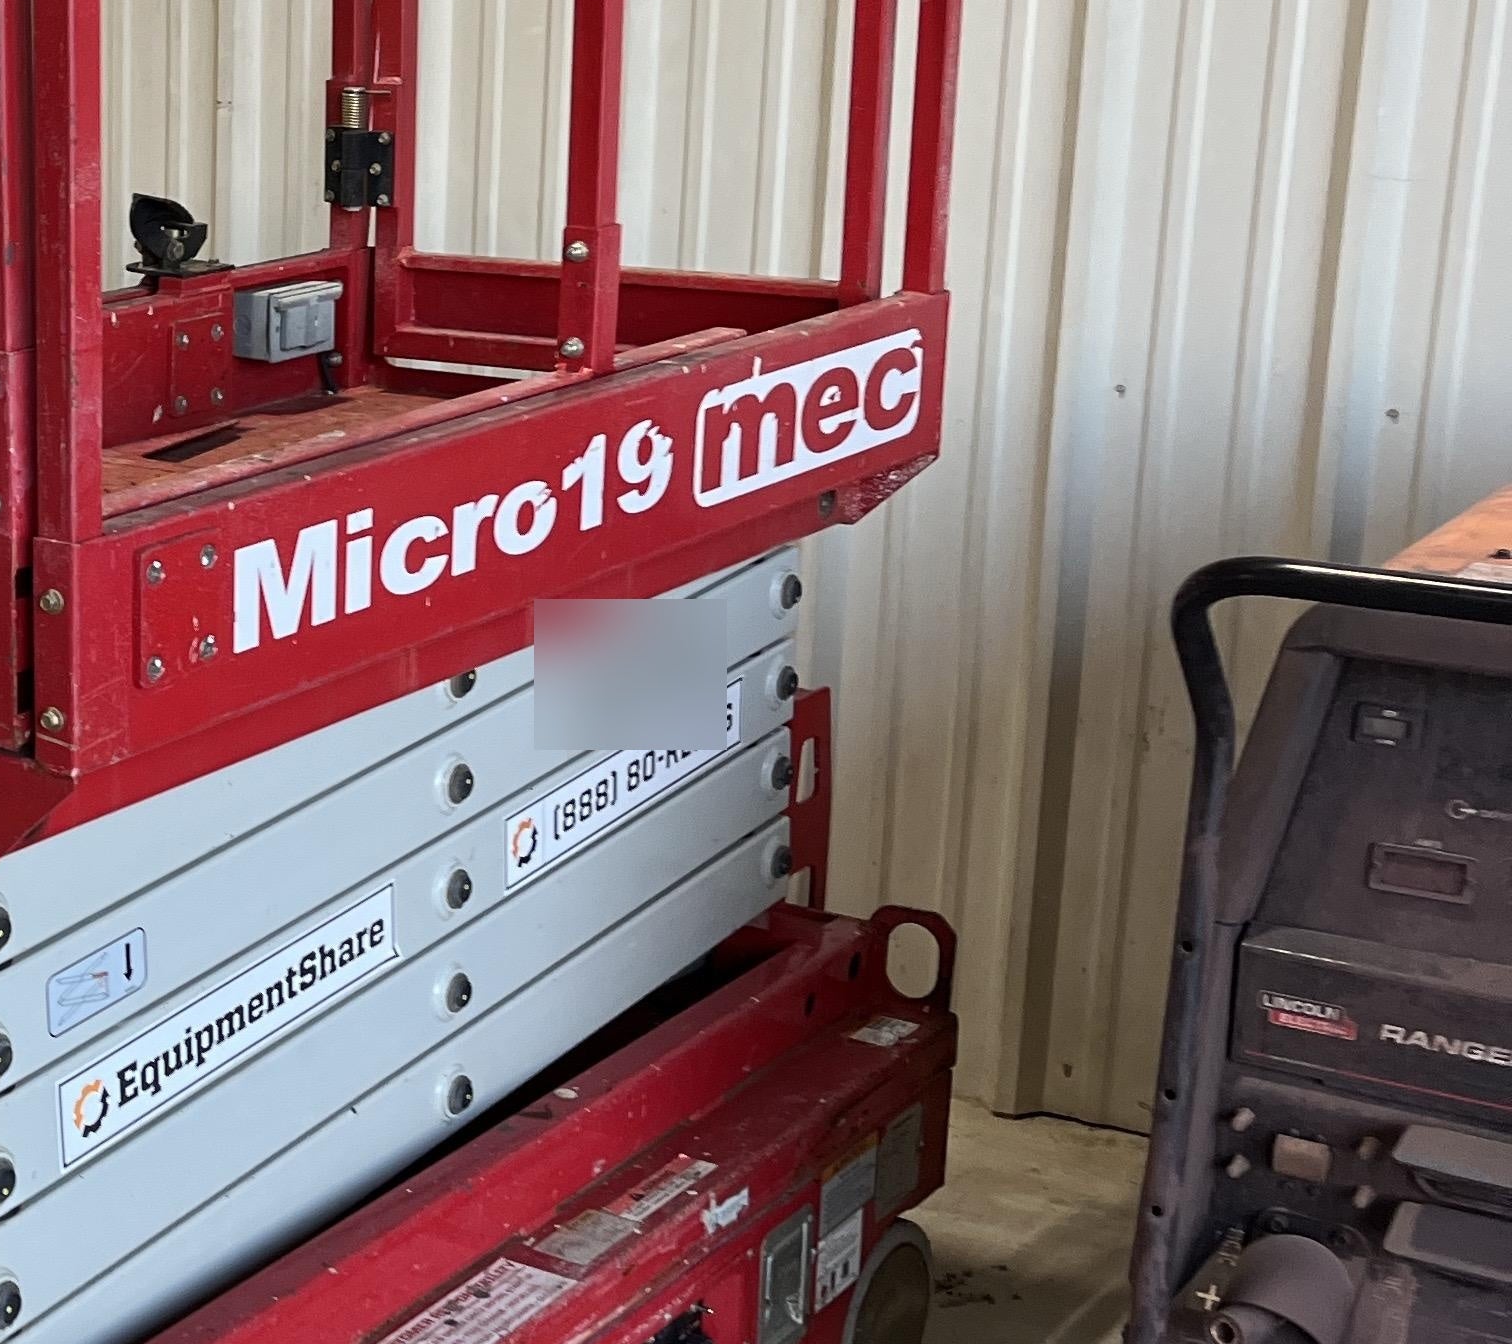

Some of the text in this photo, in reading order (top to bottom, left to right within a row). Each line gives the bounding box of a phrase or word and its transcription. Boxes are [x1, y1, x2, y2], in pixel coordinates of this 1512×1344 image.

[702, 336, 922, 492] mec
[553, 770, 618, 840] (888)
[114, 915, 386, 1111] EquipmentShare
